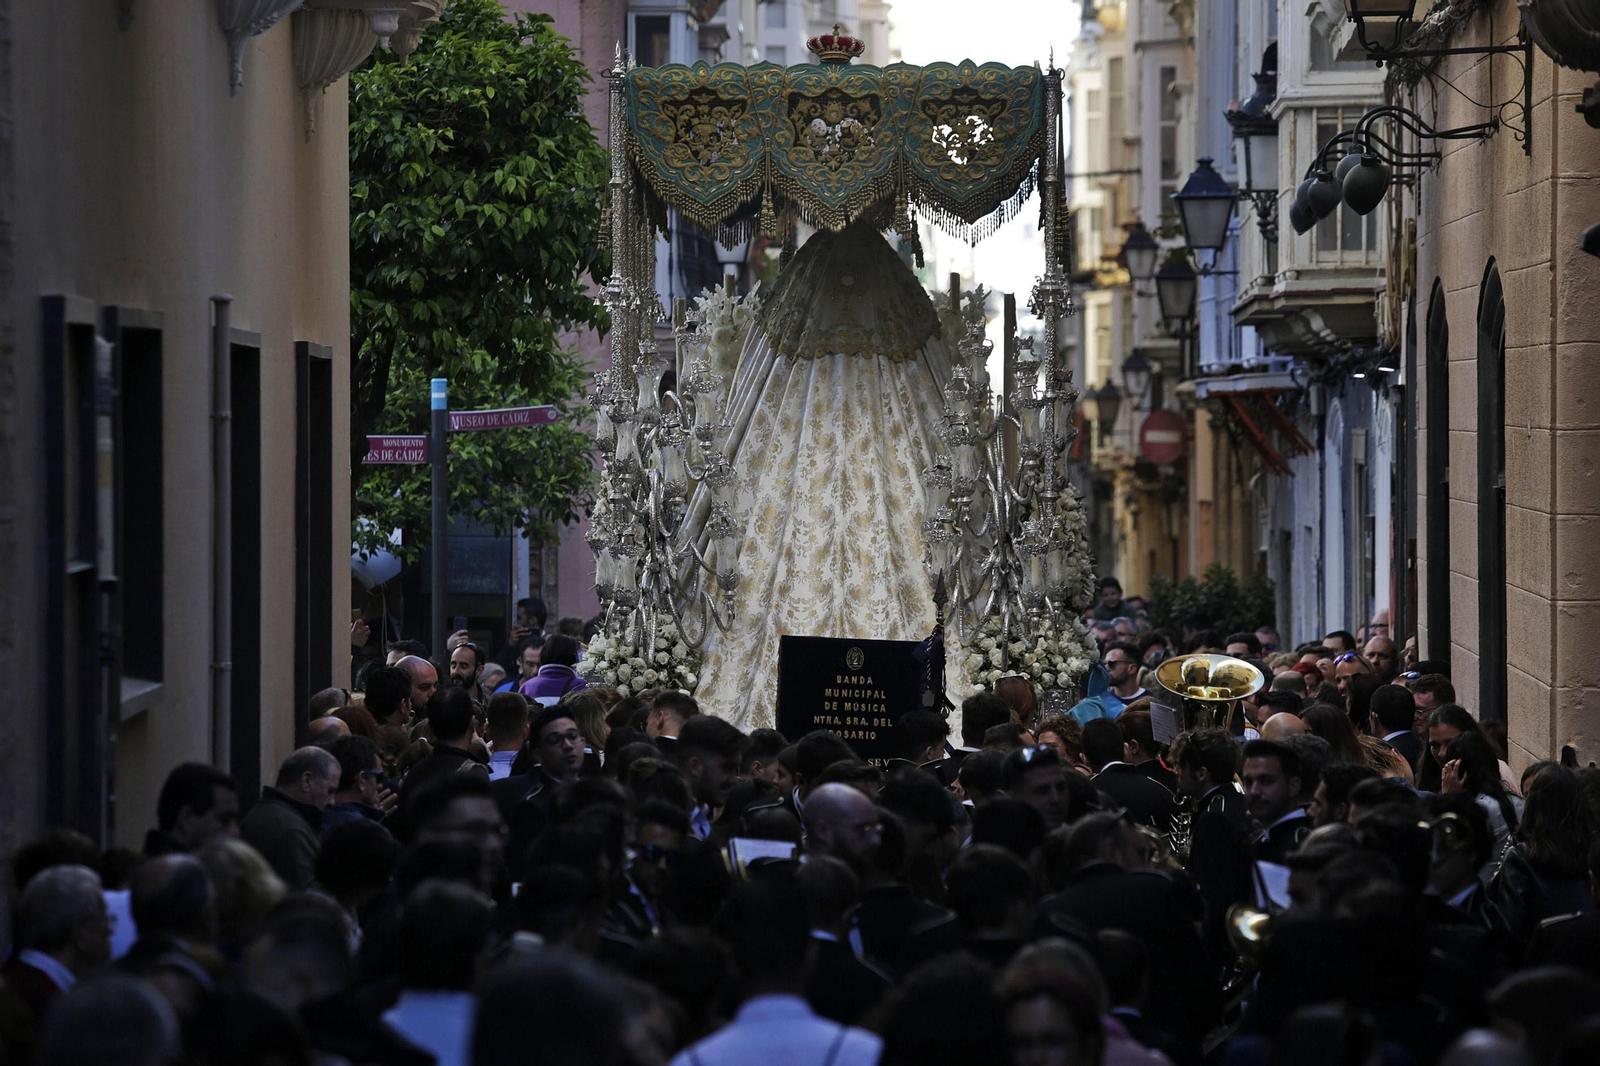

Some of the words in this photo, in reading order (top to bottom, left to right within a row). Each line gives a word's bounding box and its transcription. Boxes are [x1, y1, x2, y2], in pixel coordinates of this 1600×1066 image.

[451, 412, 484, 428] MUSEO
[486, 412, 500, 425] DE
[501, 410, 530, 424] CÁDIZ
[382, 439, 424, 447] MONUMENTO
[381, 449, 394, 461] DE
[395, 447, 424, 461] CÁDIZ
[836, 675, 874, 685] BANDA
[824, 688, 886, 699] MUNICIPAL
[824, 701, 838, 711] DE
[844, 701, 886, 713] MÚSICA
[873, 717, 893, 727] DEL
